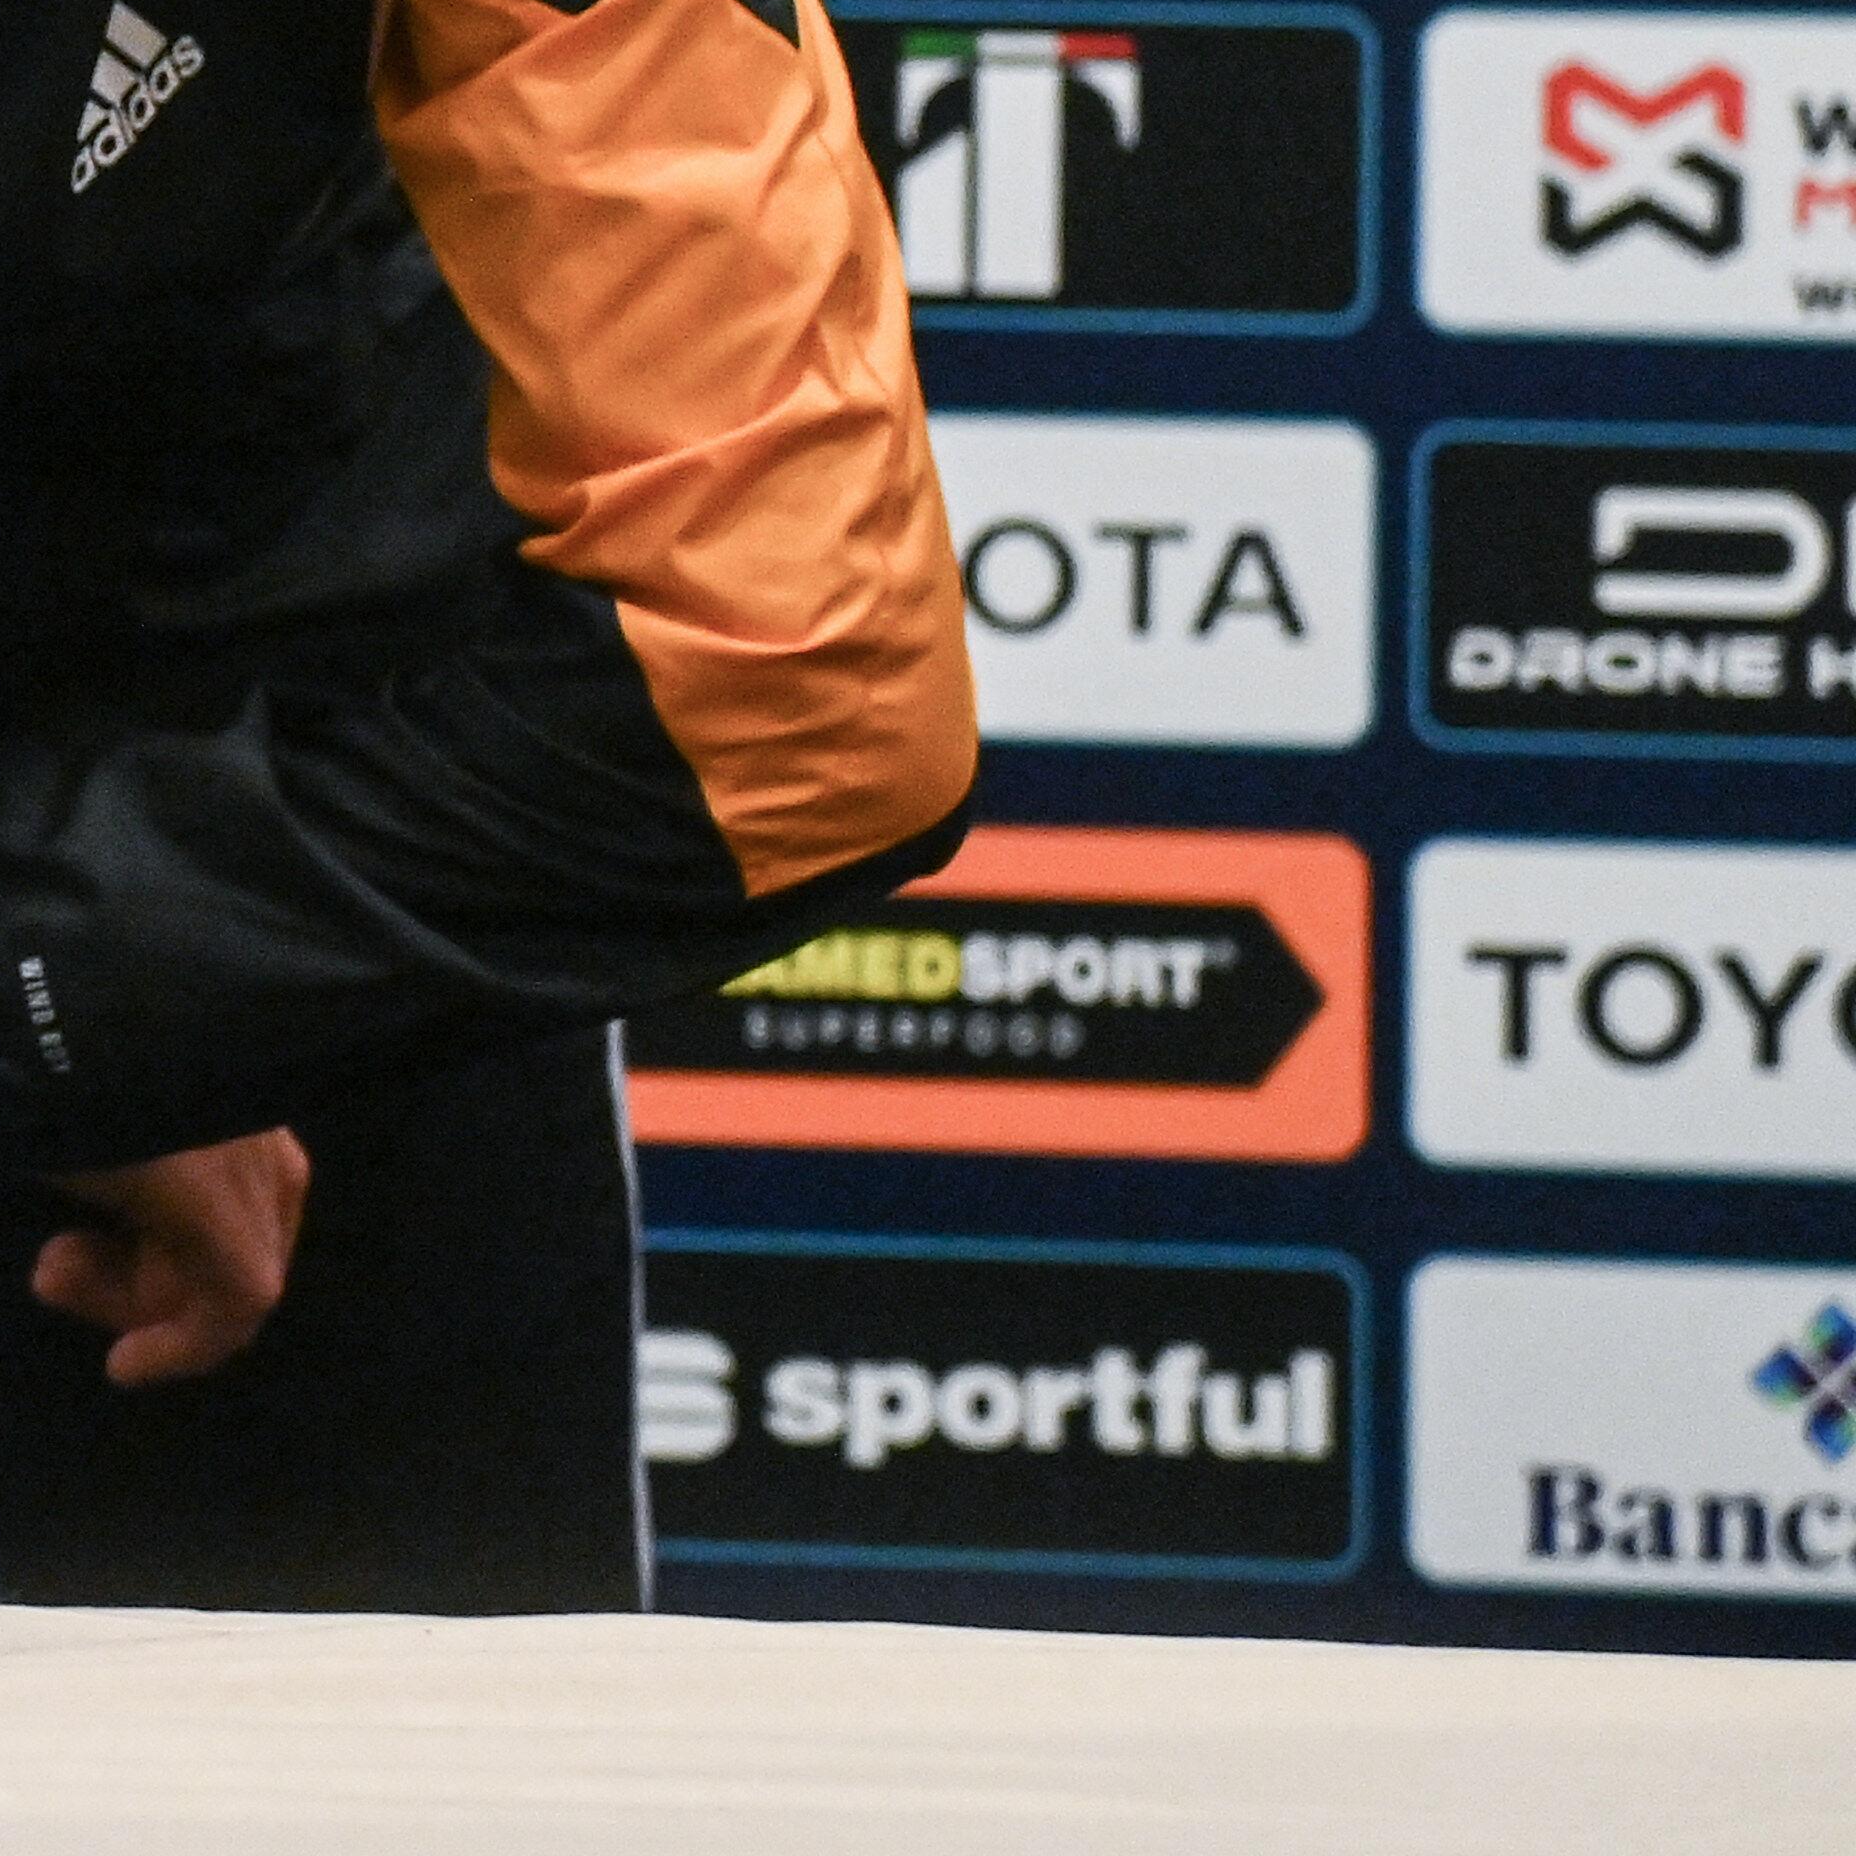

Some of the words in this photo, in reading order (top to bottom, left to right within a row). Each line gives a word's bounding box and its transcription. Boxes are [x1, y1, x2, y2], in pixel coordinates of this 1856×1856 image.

[70, 34, 206, 195] adidas
[1449, 624, 1783, 697] DRONE
[718, 928, 1208, 1008] AMEDSPORT
[1464, 942, 1856, 1074] TOY
[766, 1345, 1332, 1467] sportful
[1524, 1459, 1856, 1570] Banc
